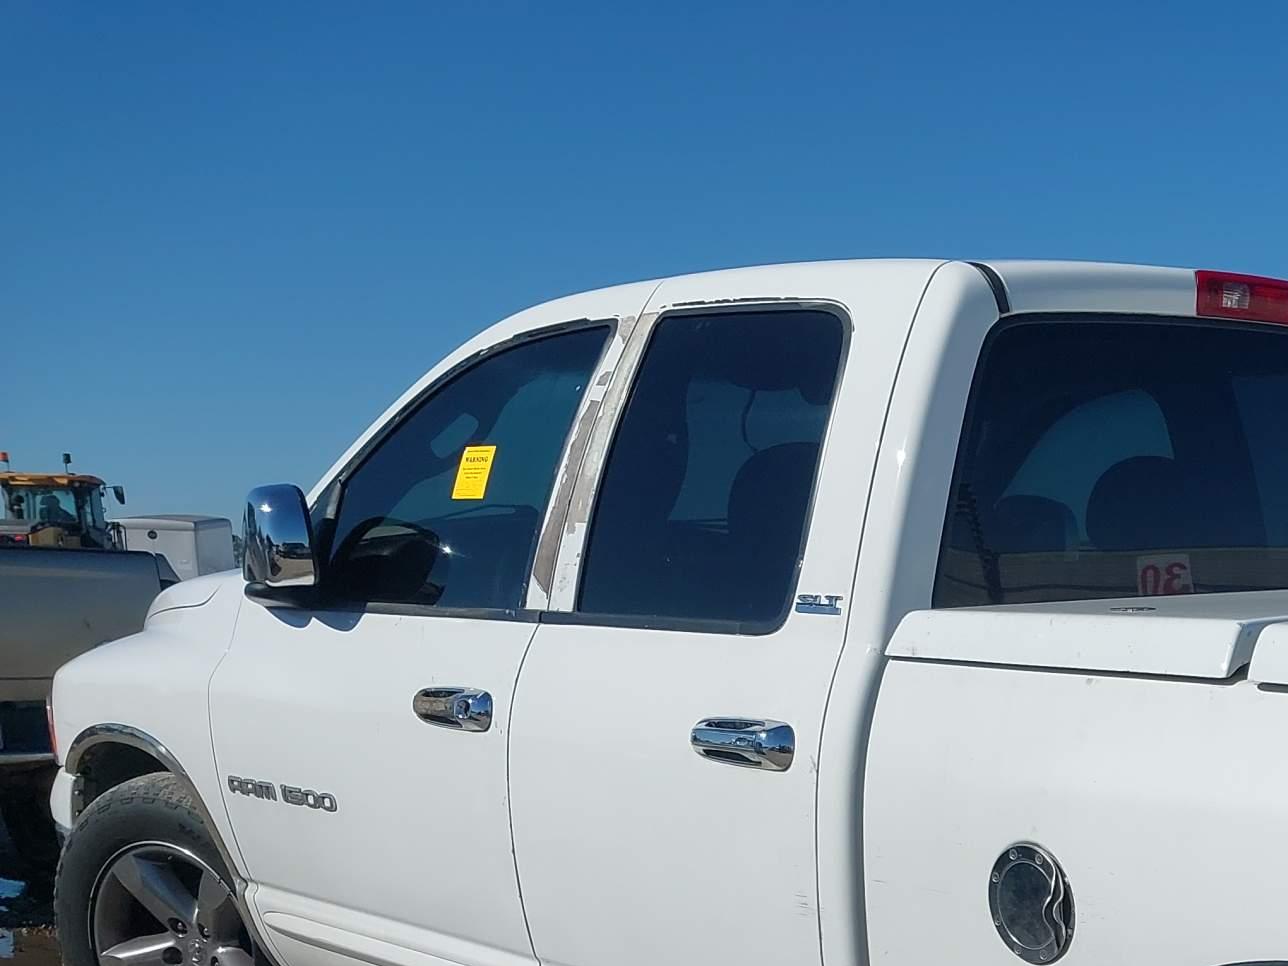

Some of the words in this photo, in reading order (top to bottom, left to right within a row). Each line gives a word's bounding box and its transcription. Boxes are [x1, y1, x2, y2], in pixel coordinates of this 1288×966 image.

[797, 594, 844, 609] SLT
[227, 775, 278, 801] RAM
[279, 783, 338, 812] 1500
